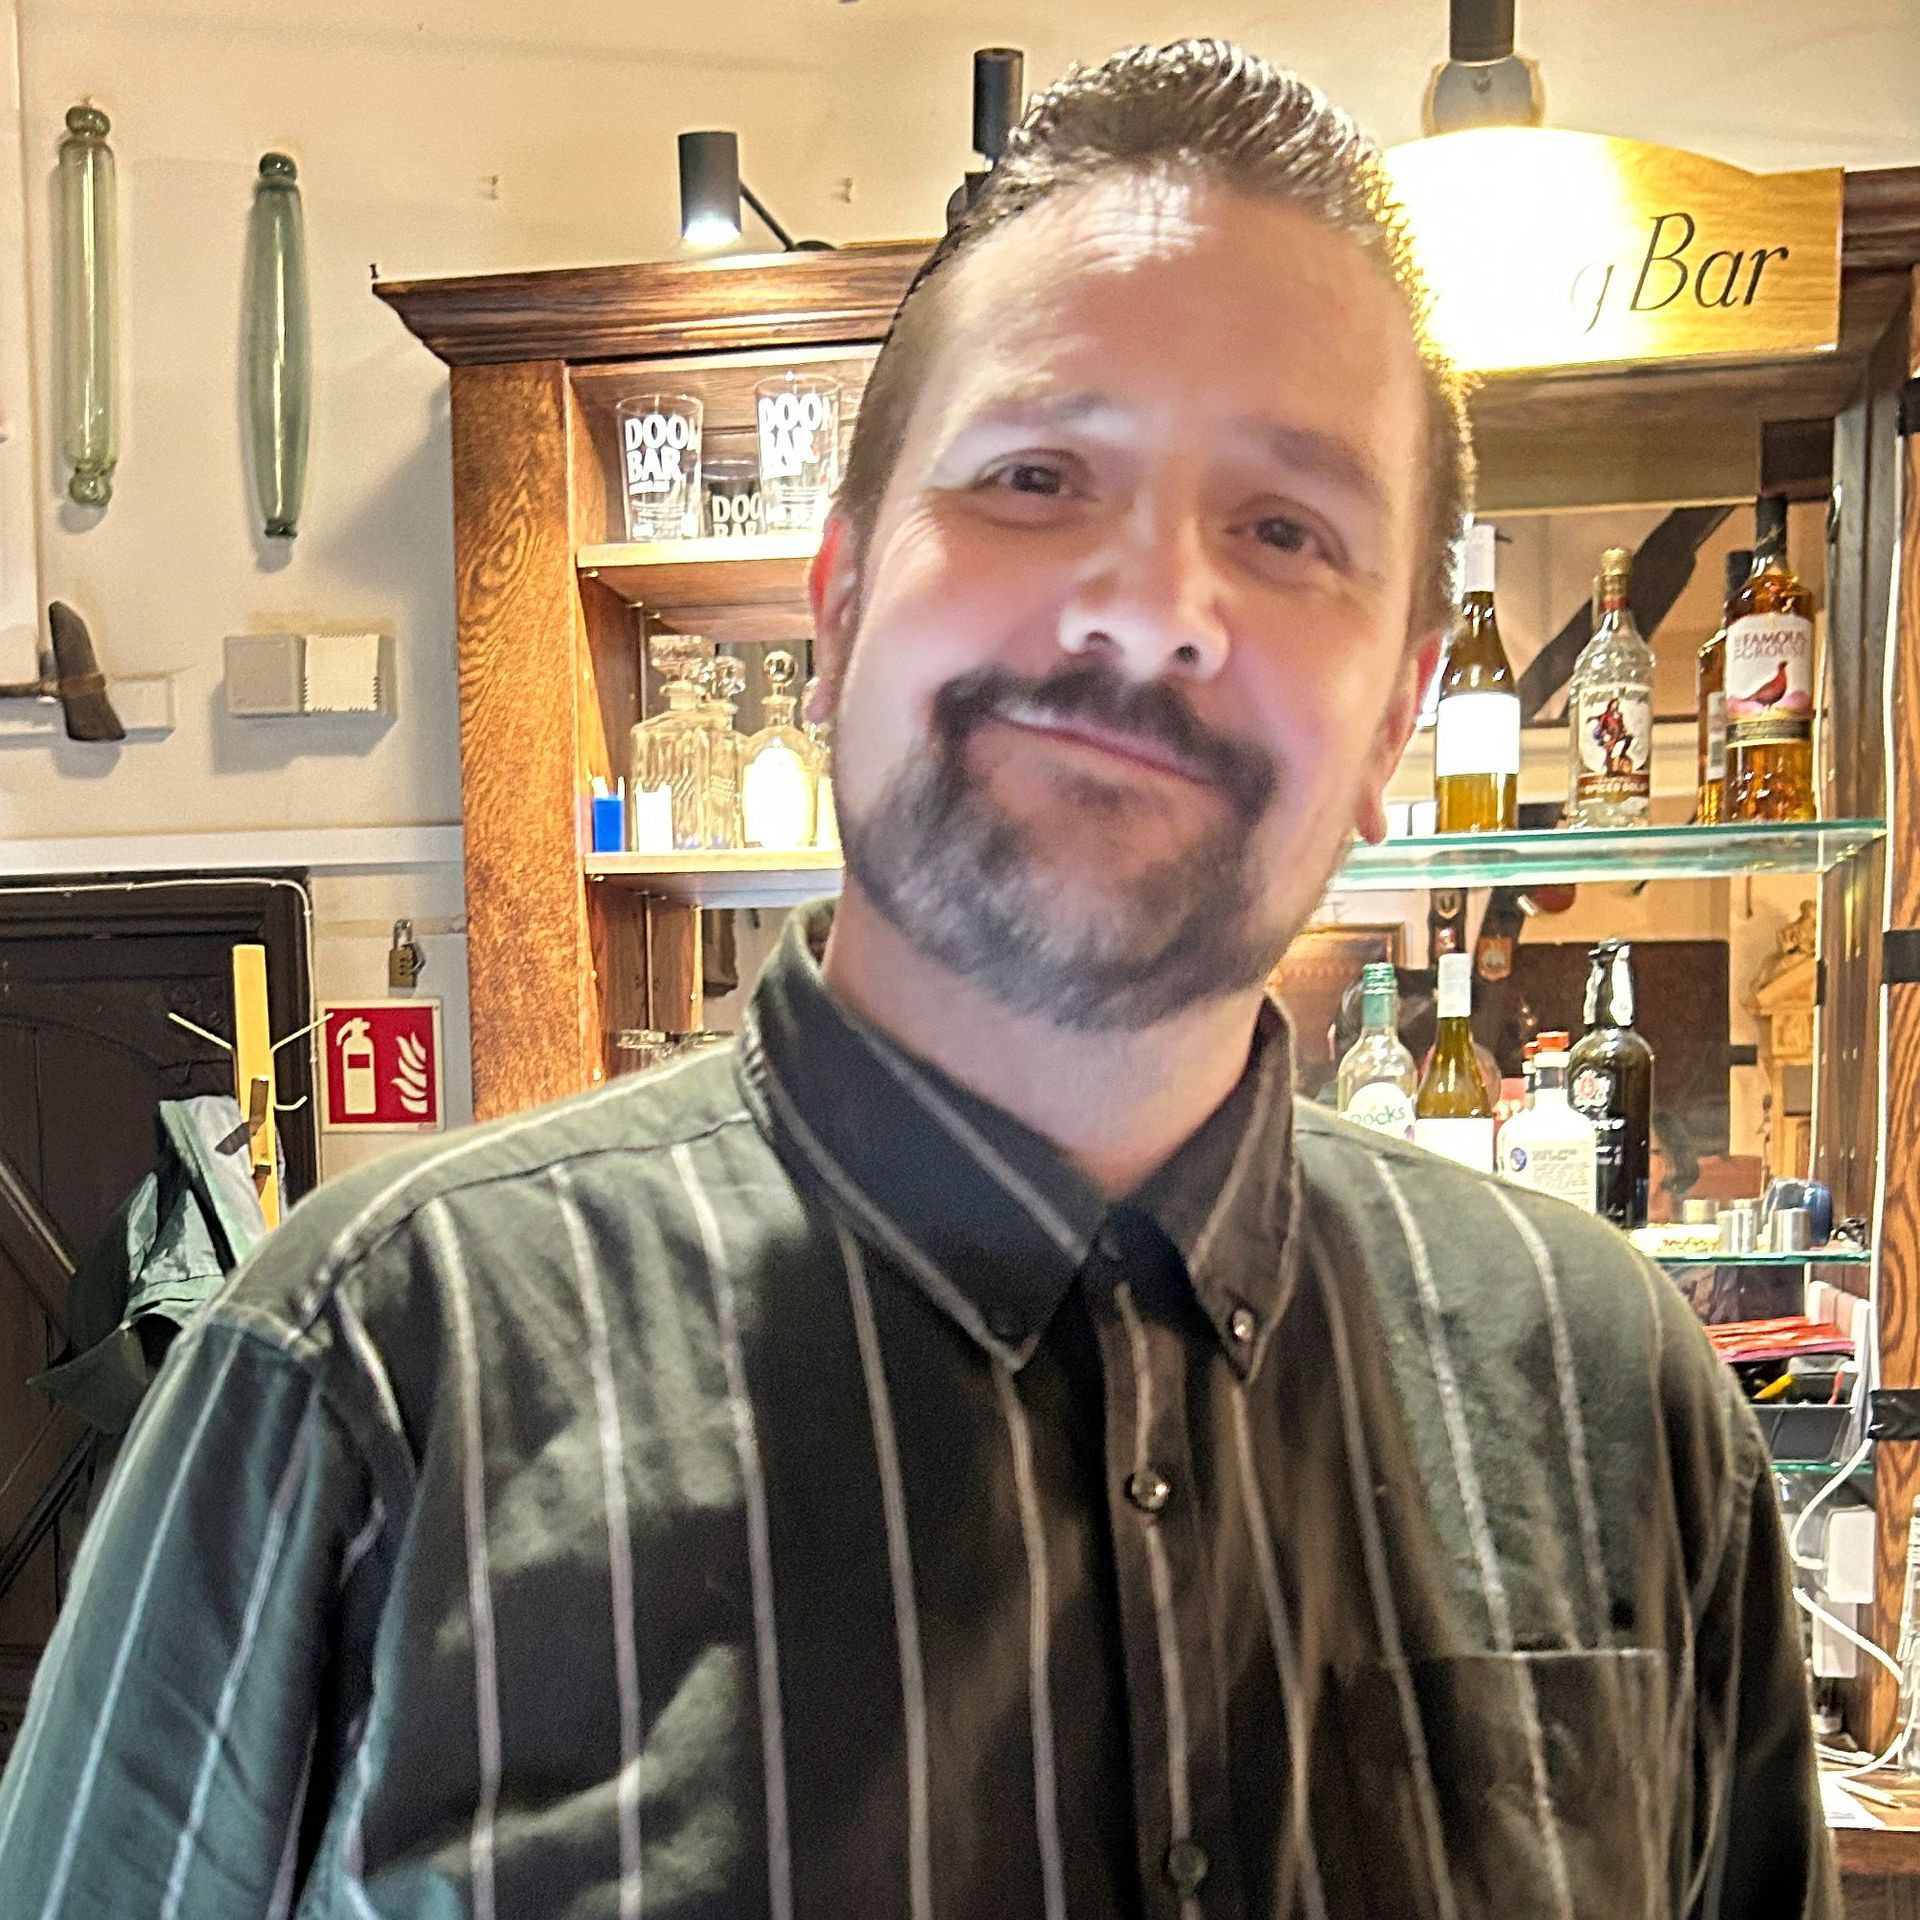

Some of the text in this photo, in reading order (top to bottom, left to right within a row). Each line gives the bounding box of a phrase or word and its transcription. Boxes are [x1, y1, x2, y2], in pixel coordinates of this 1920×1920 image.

[1629, 212, 1790, 311] Bar
[627, 446, 686, 483] BAR
[760, 427, 820, 467] BAR
